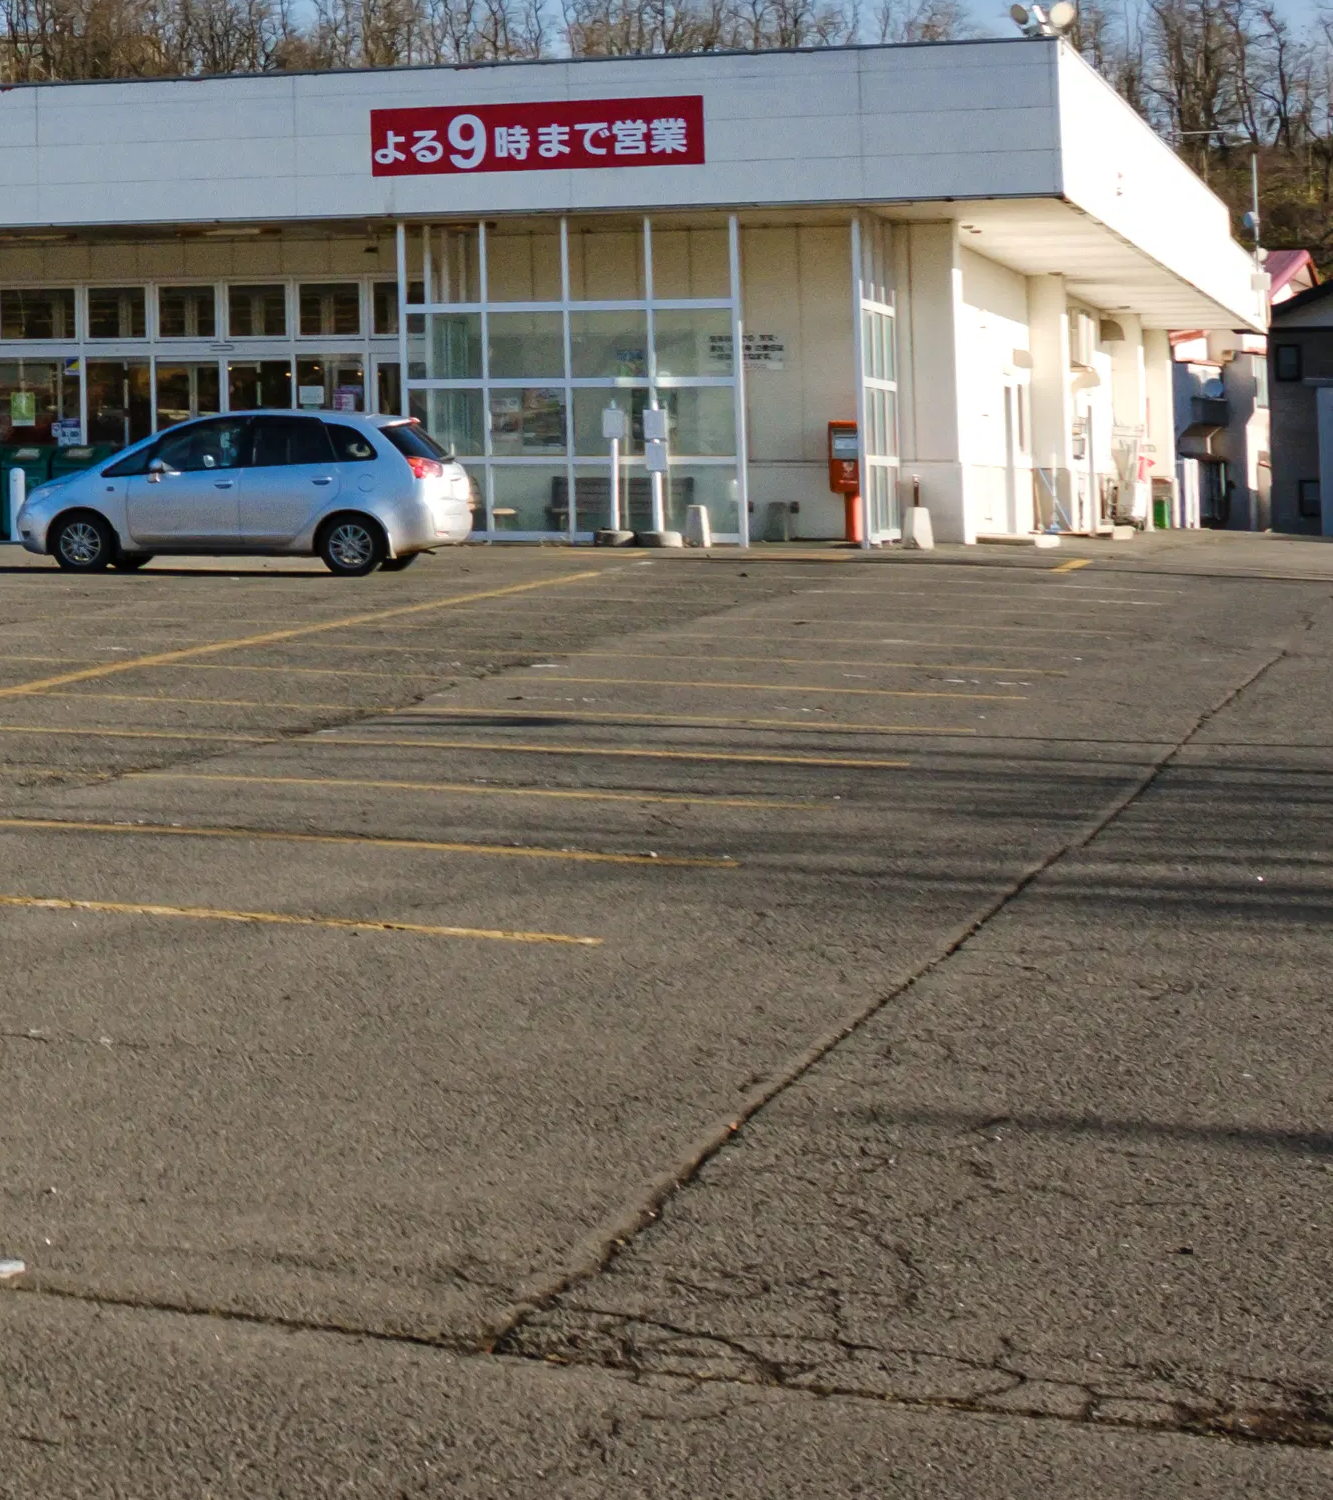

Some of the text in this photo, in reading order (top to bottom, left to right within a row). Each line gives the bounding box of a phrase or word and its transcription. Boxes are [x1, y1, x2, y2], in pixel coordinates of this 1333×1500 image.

[374, 113, 688, 169] よる9時まで営業
